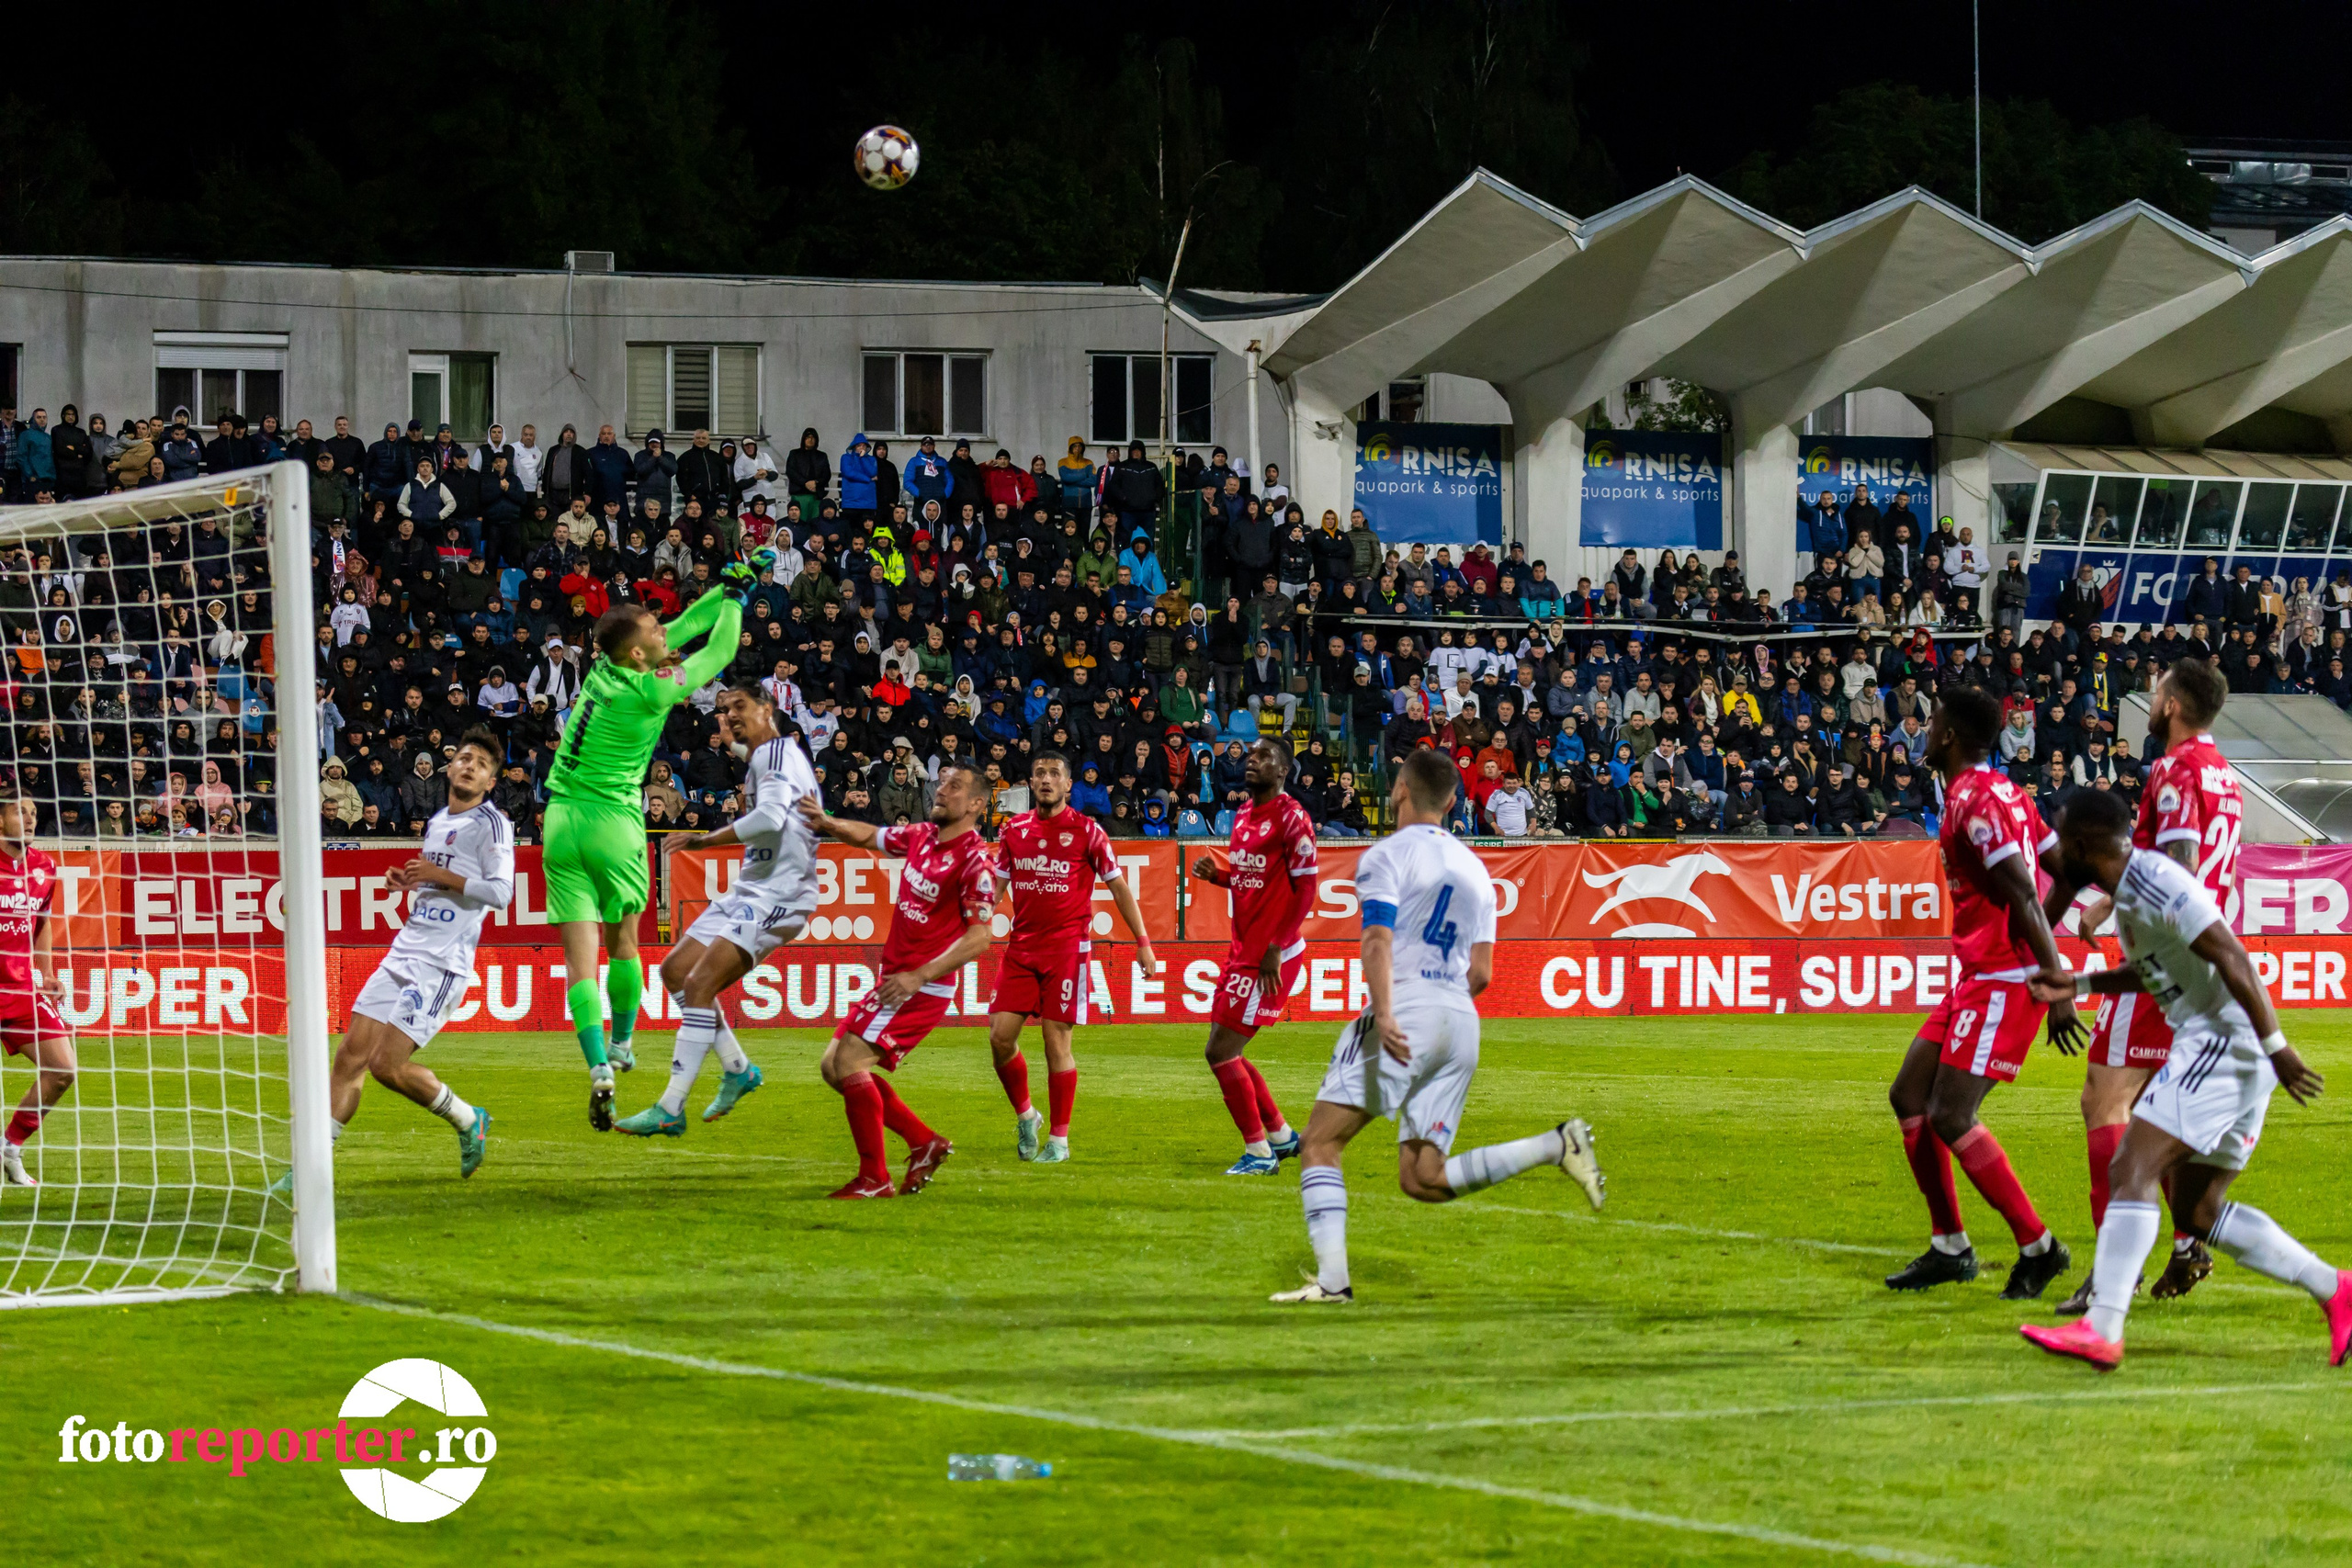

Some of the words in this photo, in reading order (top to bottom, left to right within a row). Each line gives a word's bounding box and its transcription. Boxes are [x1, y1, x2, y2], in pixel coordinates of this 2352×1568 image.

[1432, 480, 1442, 494] &
[1451, 481, 1498, 498] sports
[1656, 487, 1665, 500] &
[1672, 488, 1719, 502] sports
[2131, 571, 2177, 606] FC
[571, 700, 594, 756] 1
[1014, 854, 1070, 874] WIN2.RO
[1770, 874, 1940, 922] Vestra
[1423, 885, 1459, 963] 4
[31, 967, 250, 1026] UPER
[1061, 979, 1073, 1001] 9
[1226, 974, 1253, 998] 28
[1540, 955, 1625, 1009] CU
[1639, 955, 1786, 1014] TINE,
[1954, 1010, 1977, 1038] 8
[2092, 999, 2113, 1032] 4
